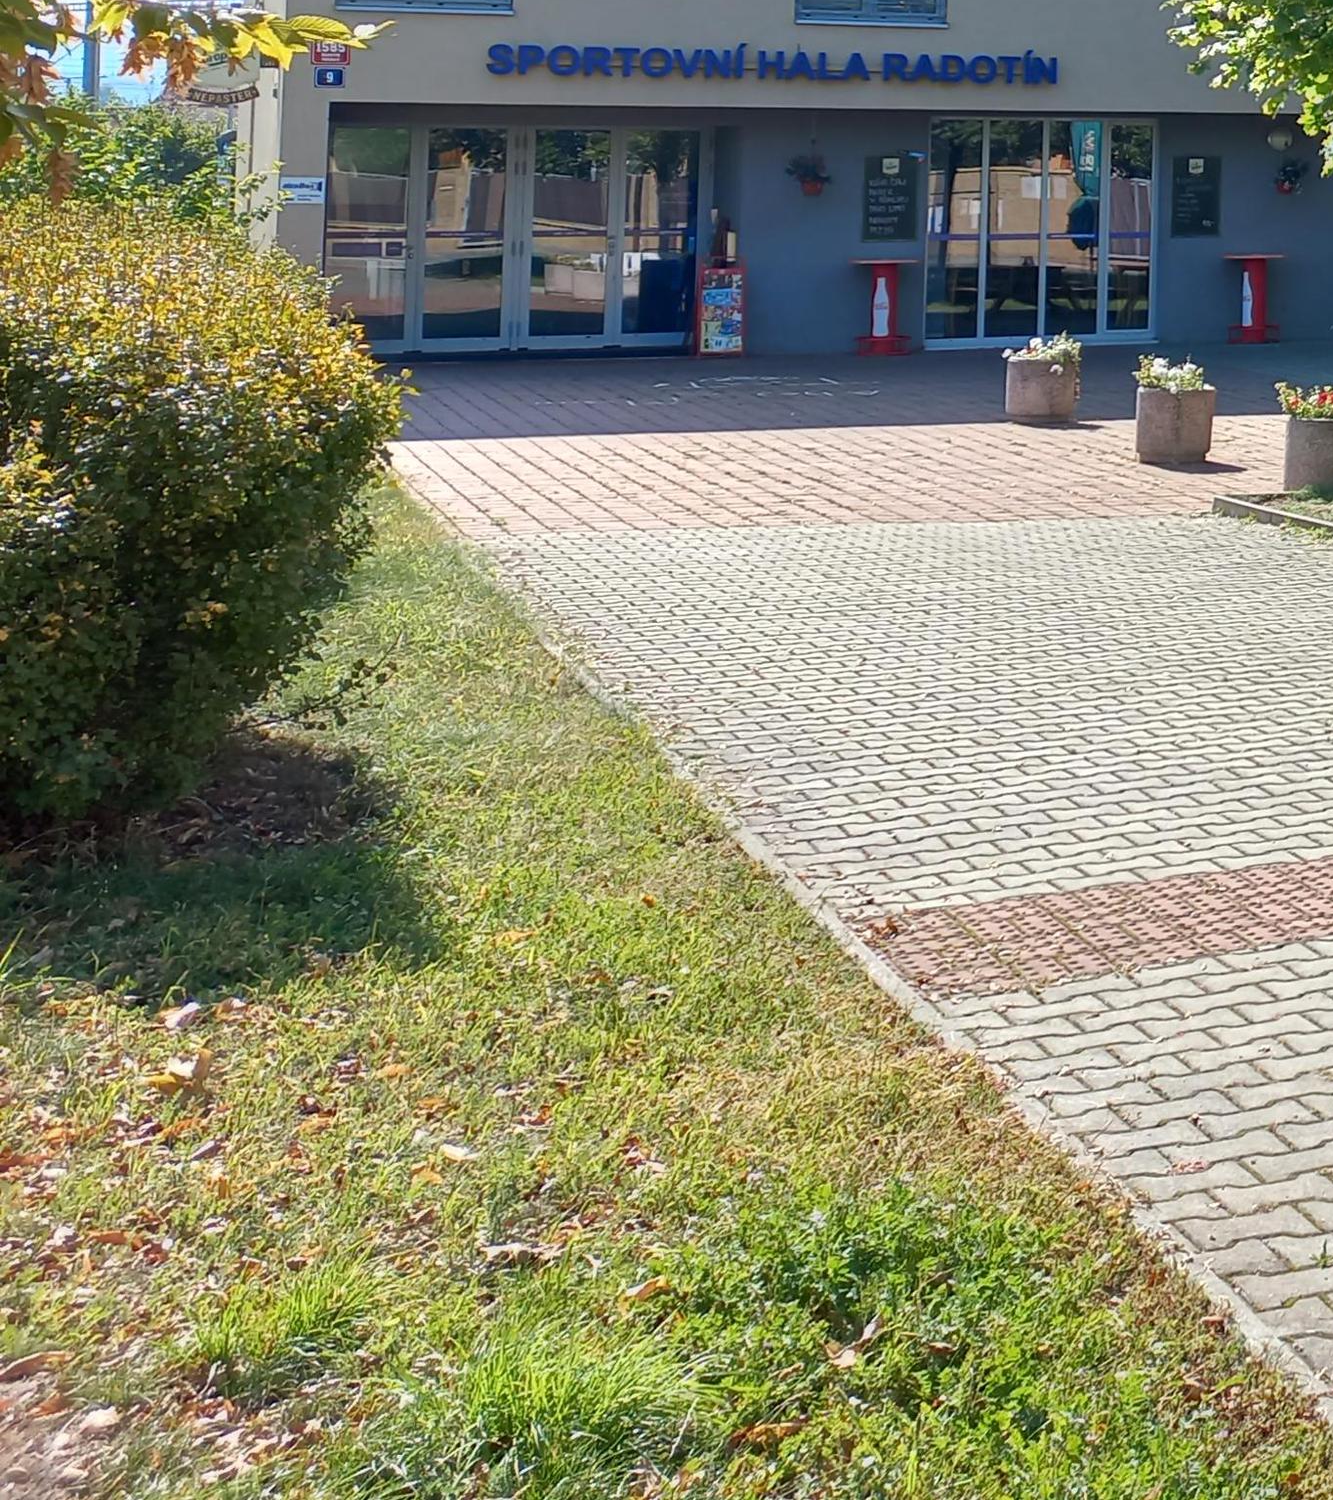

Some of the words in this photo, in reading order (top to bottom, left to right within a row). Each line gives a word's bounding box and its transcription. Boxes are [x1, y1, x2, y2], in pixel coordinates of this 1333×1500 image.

[316, 41, 346, 53] 1585
[486, 43, 747, 79] SPORTOVNÍ
[757, 49, 871, 81] HALA
[882, 50, 1058, 85] RADOTÍN
[326, 71, 334, 83] 9
